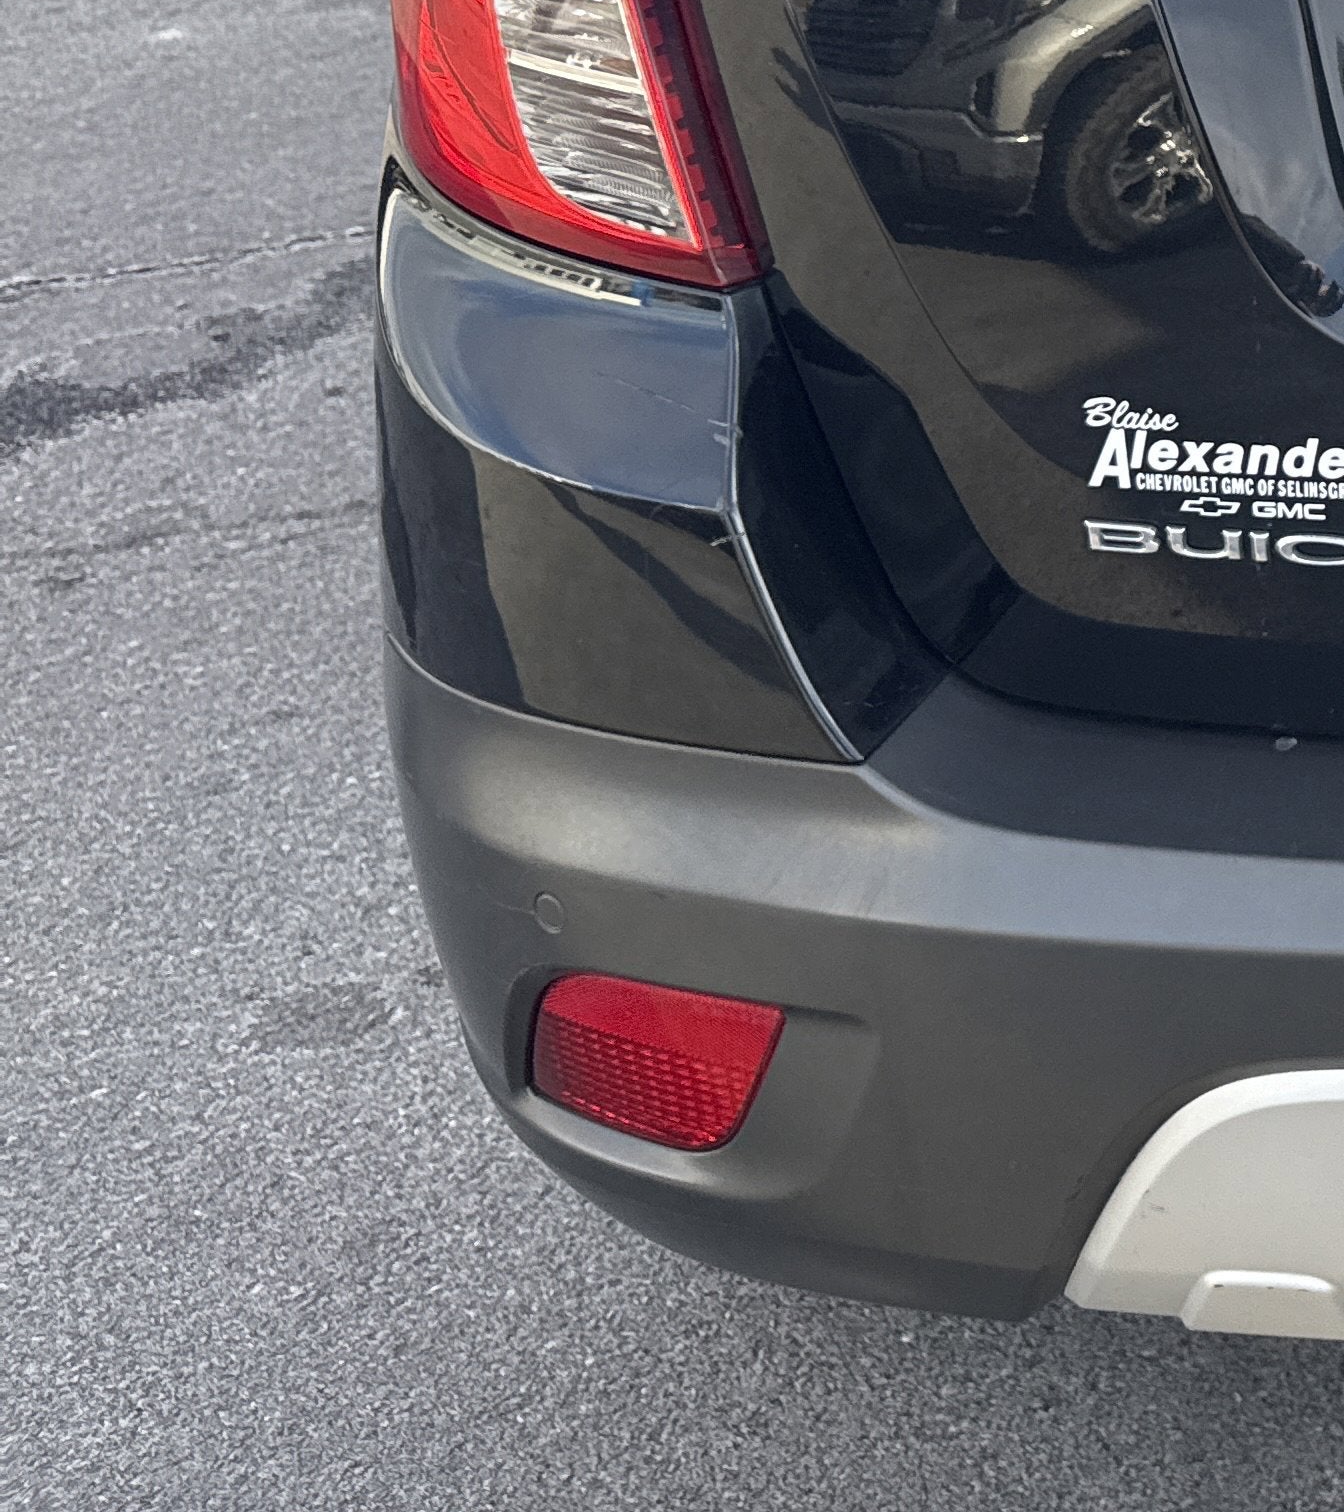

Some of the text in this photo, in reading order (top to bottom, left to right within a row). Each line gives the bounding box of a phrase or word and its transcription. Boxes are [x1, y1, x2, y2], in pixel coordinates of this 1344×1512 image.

[1083, 396, 1180, 432] Blaise
[1135, 472, 1218, 495] CHEVROLET
[1221, 476, 1255, 497] GMC
[1257, 479, 1276, 497] OF
[1252, 500, 1328, 521] GMC
